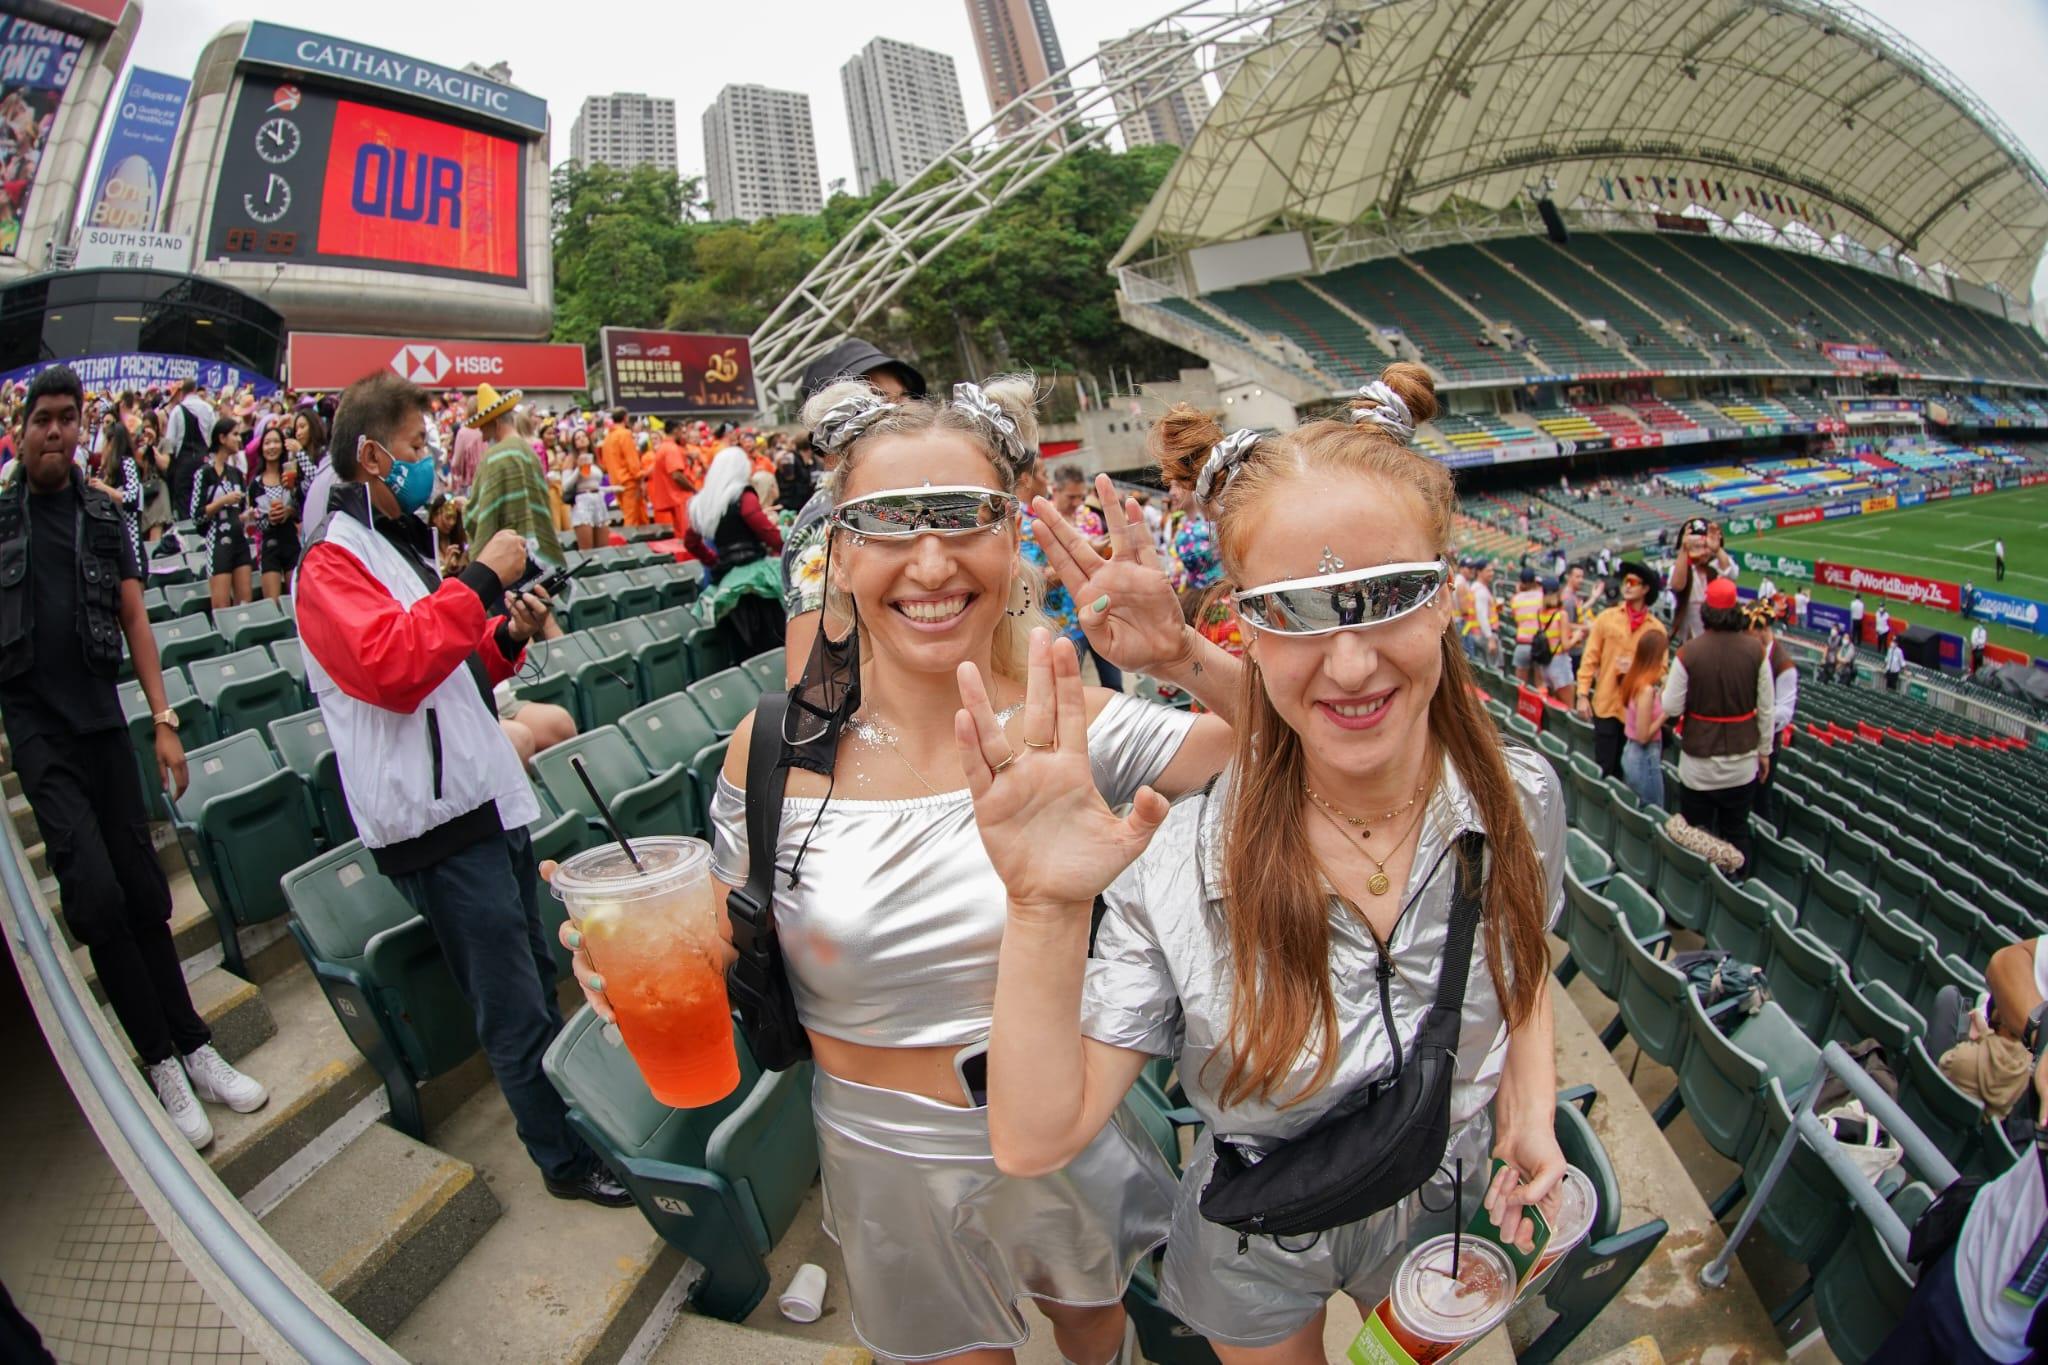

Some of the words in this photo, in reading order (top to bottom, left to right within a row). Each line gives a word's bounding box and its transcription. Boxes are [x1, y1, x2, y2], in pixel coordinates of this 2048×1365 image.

[0, 43, 50, 81] ONG
[297, 40, 410, 82] CATHAY
[414, 67, 509, 112] PACIFIC
[352, 143, 463, 229] OUR
[90, 232, 136, 246] SOUTH
[138, 235, 182, 250] STAND
[455, 356, 503, 374] HSBC
[660, 1198, 682, 1212] 21
